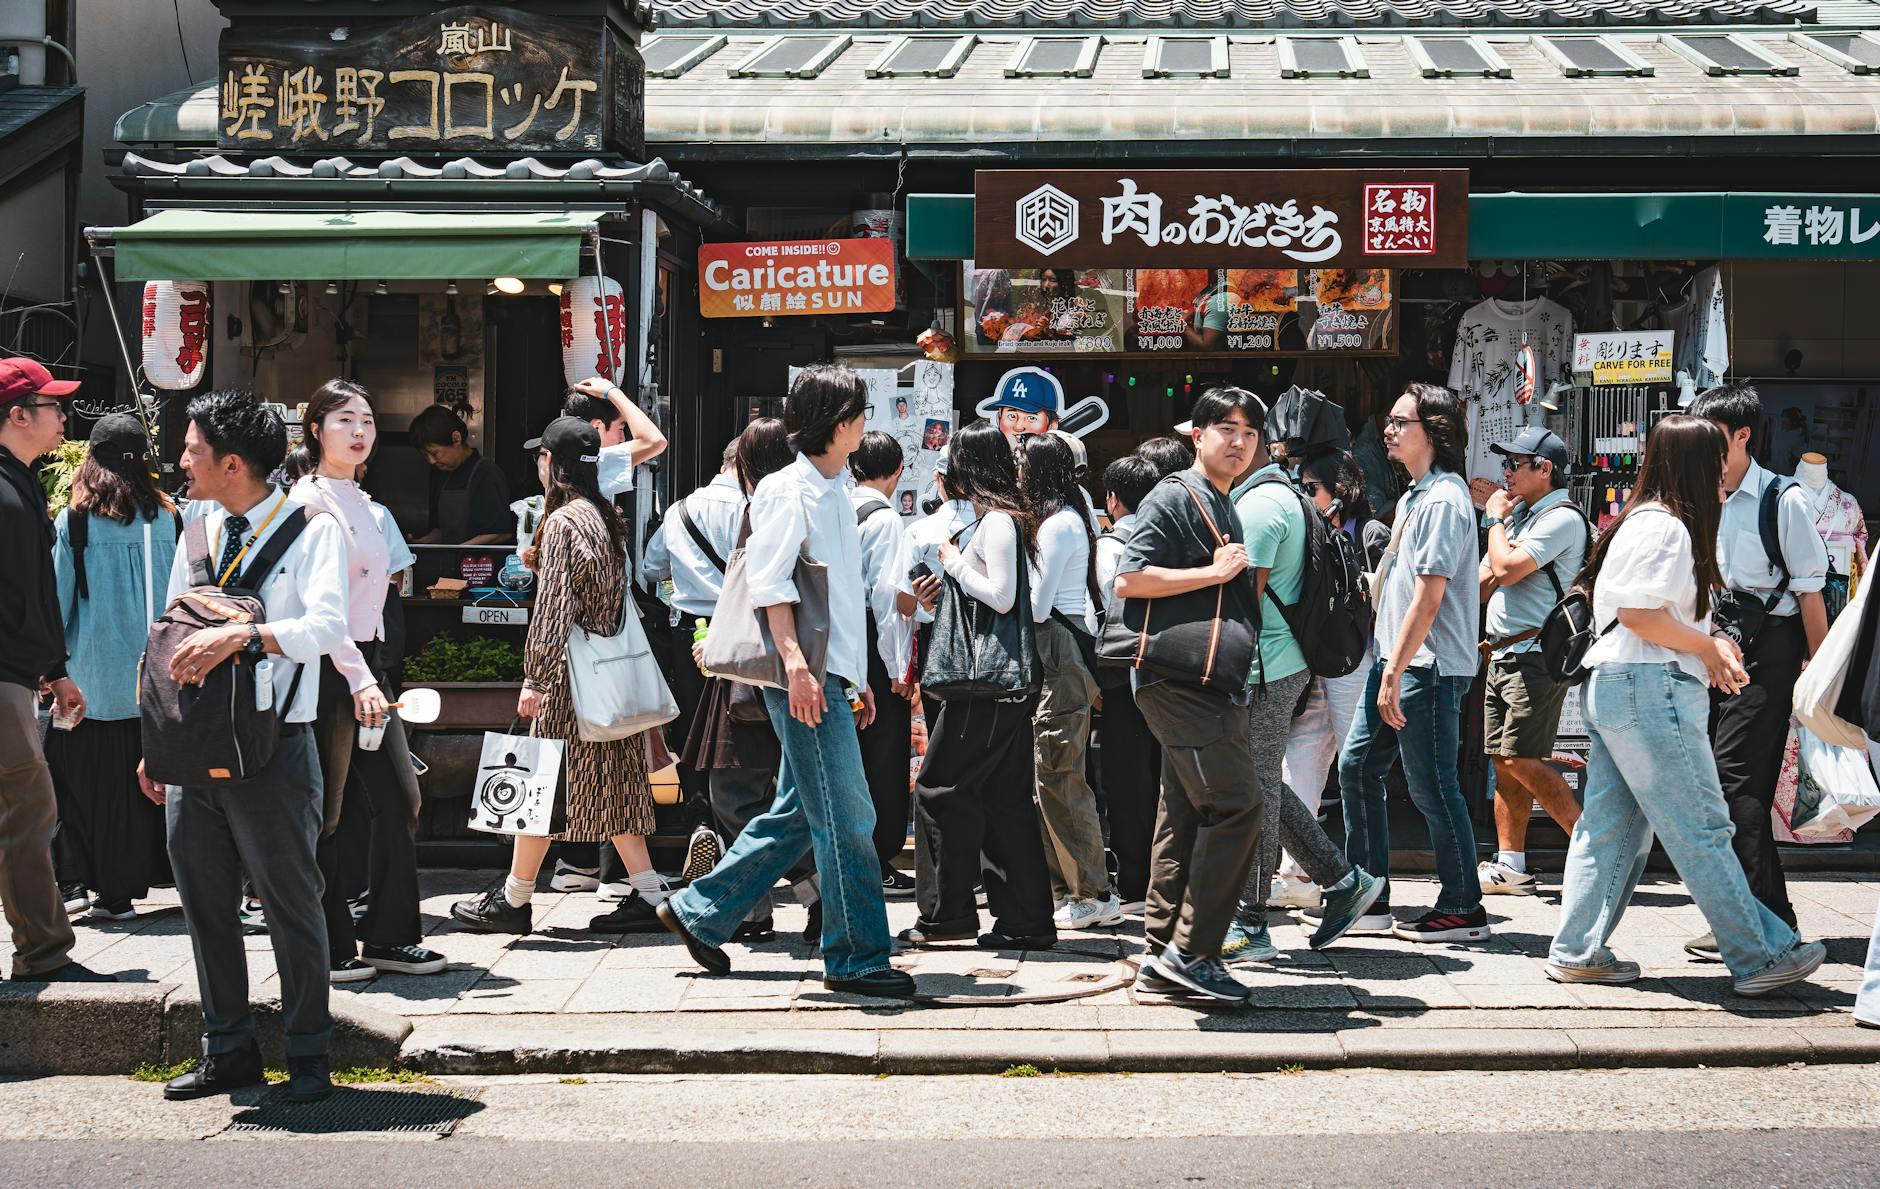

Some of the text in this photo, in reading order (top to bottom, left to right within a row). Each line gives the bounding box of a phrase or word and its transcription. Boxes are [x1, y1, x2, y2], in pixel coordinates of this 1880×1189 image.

[436, 22, 512, 55] 嵐山
[222, 63, 598, 146] 嵯峨野コロッケ
[1370, 189, 1427, 213] 名物
[1099, 178, 1342, 263] 肉のおだきち
[1368, 216, 1430, 233] 京風特大
[1763, 205, 1880, 246] 着物レ
[745, 244, 826, 257] COME INSIDE!!
[1370, 233, 1429, 249] せんべい
[704, 258, 889, 291] Caricature
[733, 291, 863, 311] 似顔絵 SUN
[1138, 336, 1183, 350] ¥1,000
[1227, 335, 1272, 349] ¥1,200
[1318, 334, 1362, 349] ¥1,500
[1596, 340, 1664, 360] 彫ります
[1594, 359, 1671, 370] CARVE FOR FREE
[1011, 378, 1028, 398] LA
[479, 610, 509, 623] OPEN
